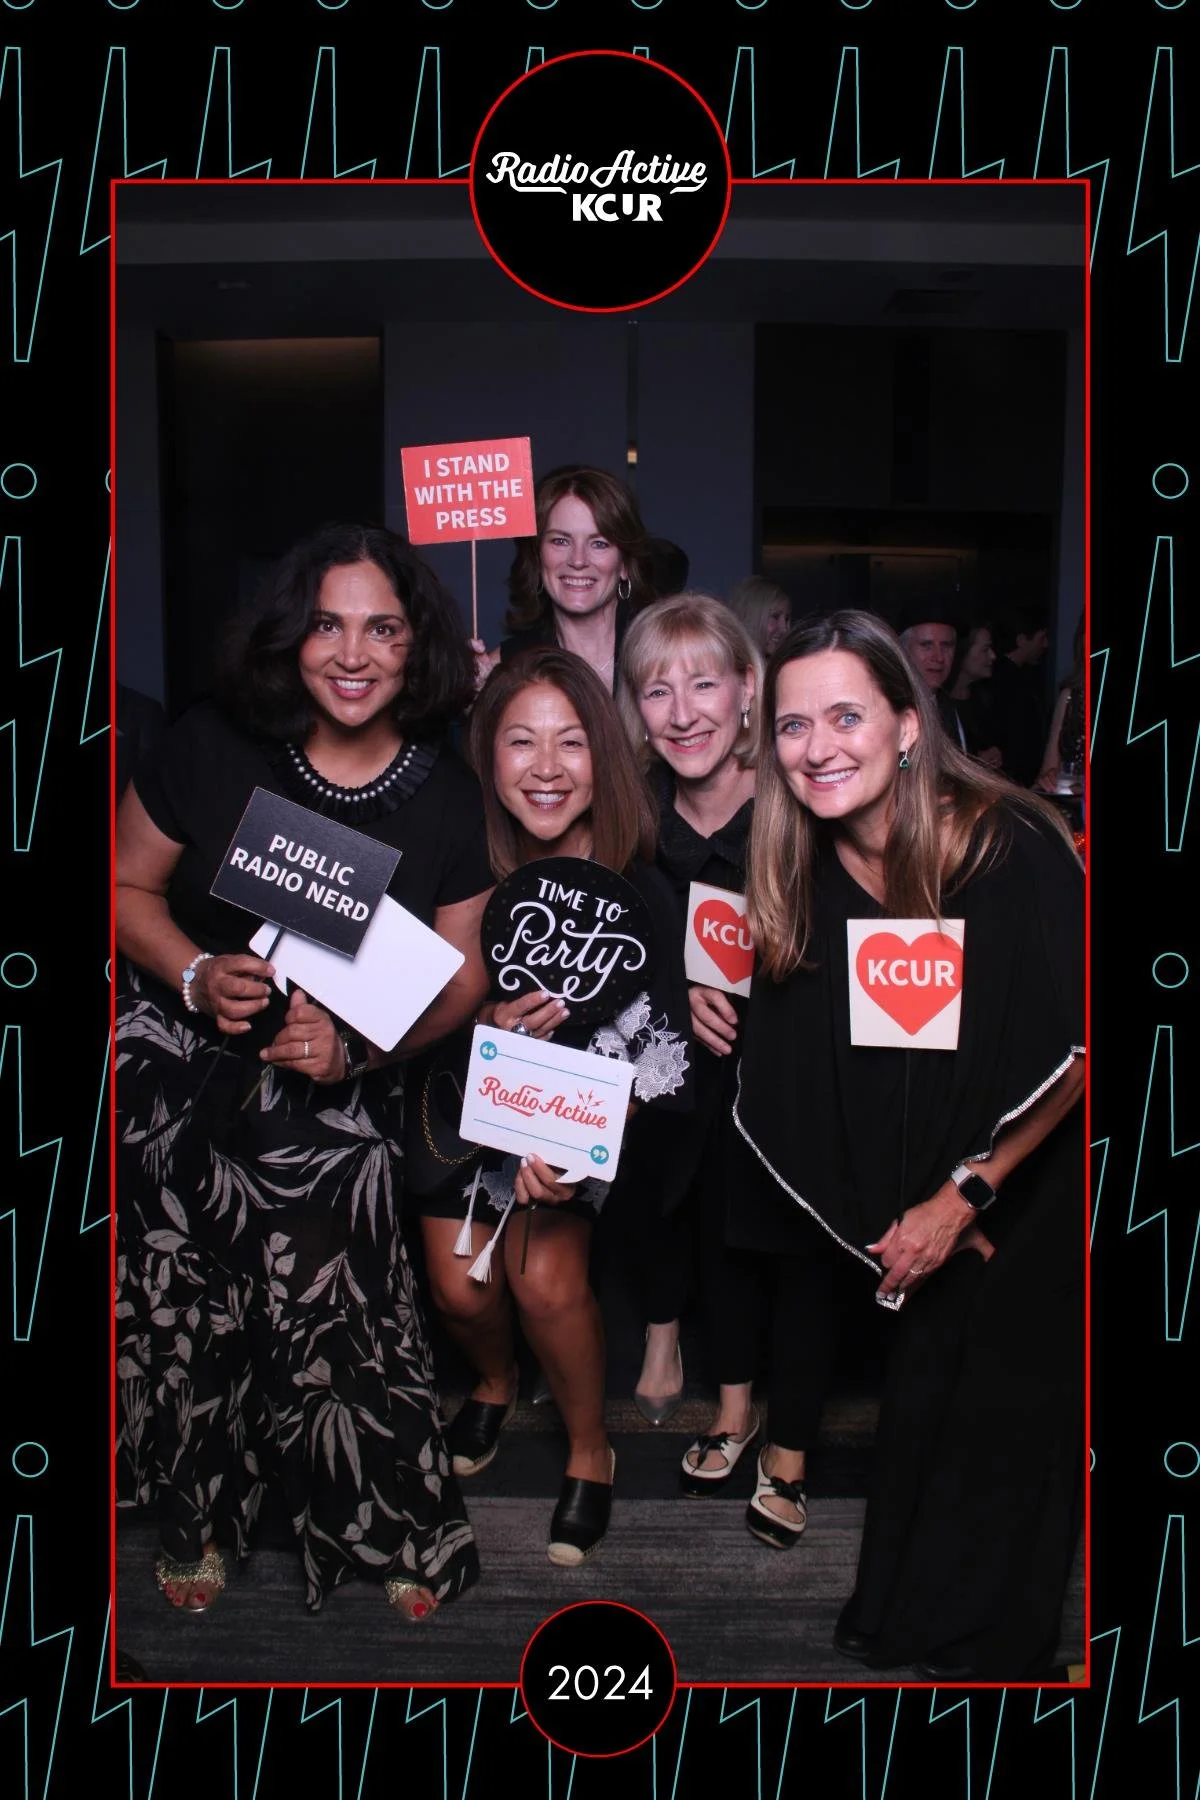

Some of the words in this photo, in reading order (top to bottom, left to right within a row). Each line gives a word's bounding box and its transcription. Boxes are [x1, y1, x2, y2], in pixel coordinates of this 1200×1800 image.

[424, 459, 431, 478] I
[436, 453, 510, 477] STAND
[414, 482, 473, 505] WITH
[478, 478, 523, 500] THE
[435, 507, 507, 530] PRESS
[268, 834, 355, 886] PUBLIC
[230, 847, 303, 892] RADIO
[305, 881, 370, 922] NERD
[538, 877, 588, 911] TIME
[595, 897, 629, 922] TO
[491, 901, 647, 1002] Party
[702, 917, 754, 951] KCU
[867, 959, 956, 988] KCUR
[478, 1076, 543, 1117] Radio
[539, 1095, 607, 1129] Active
